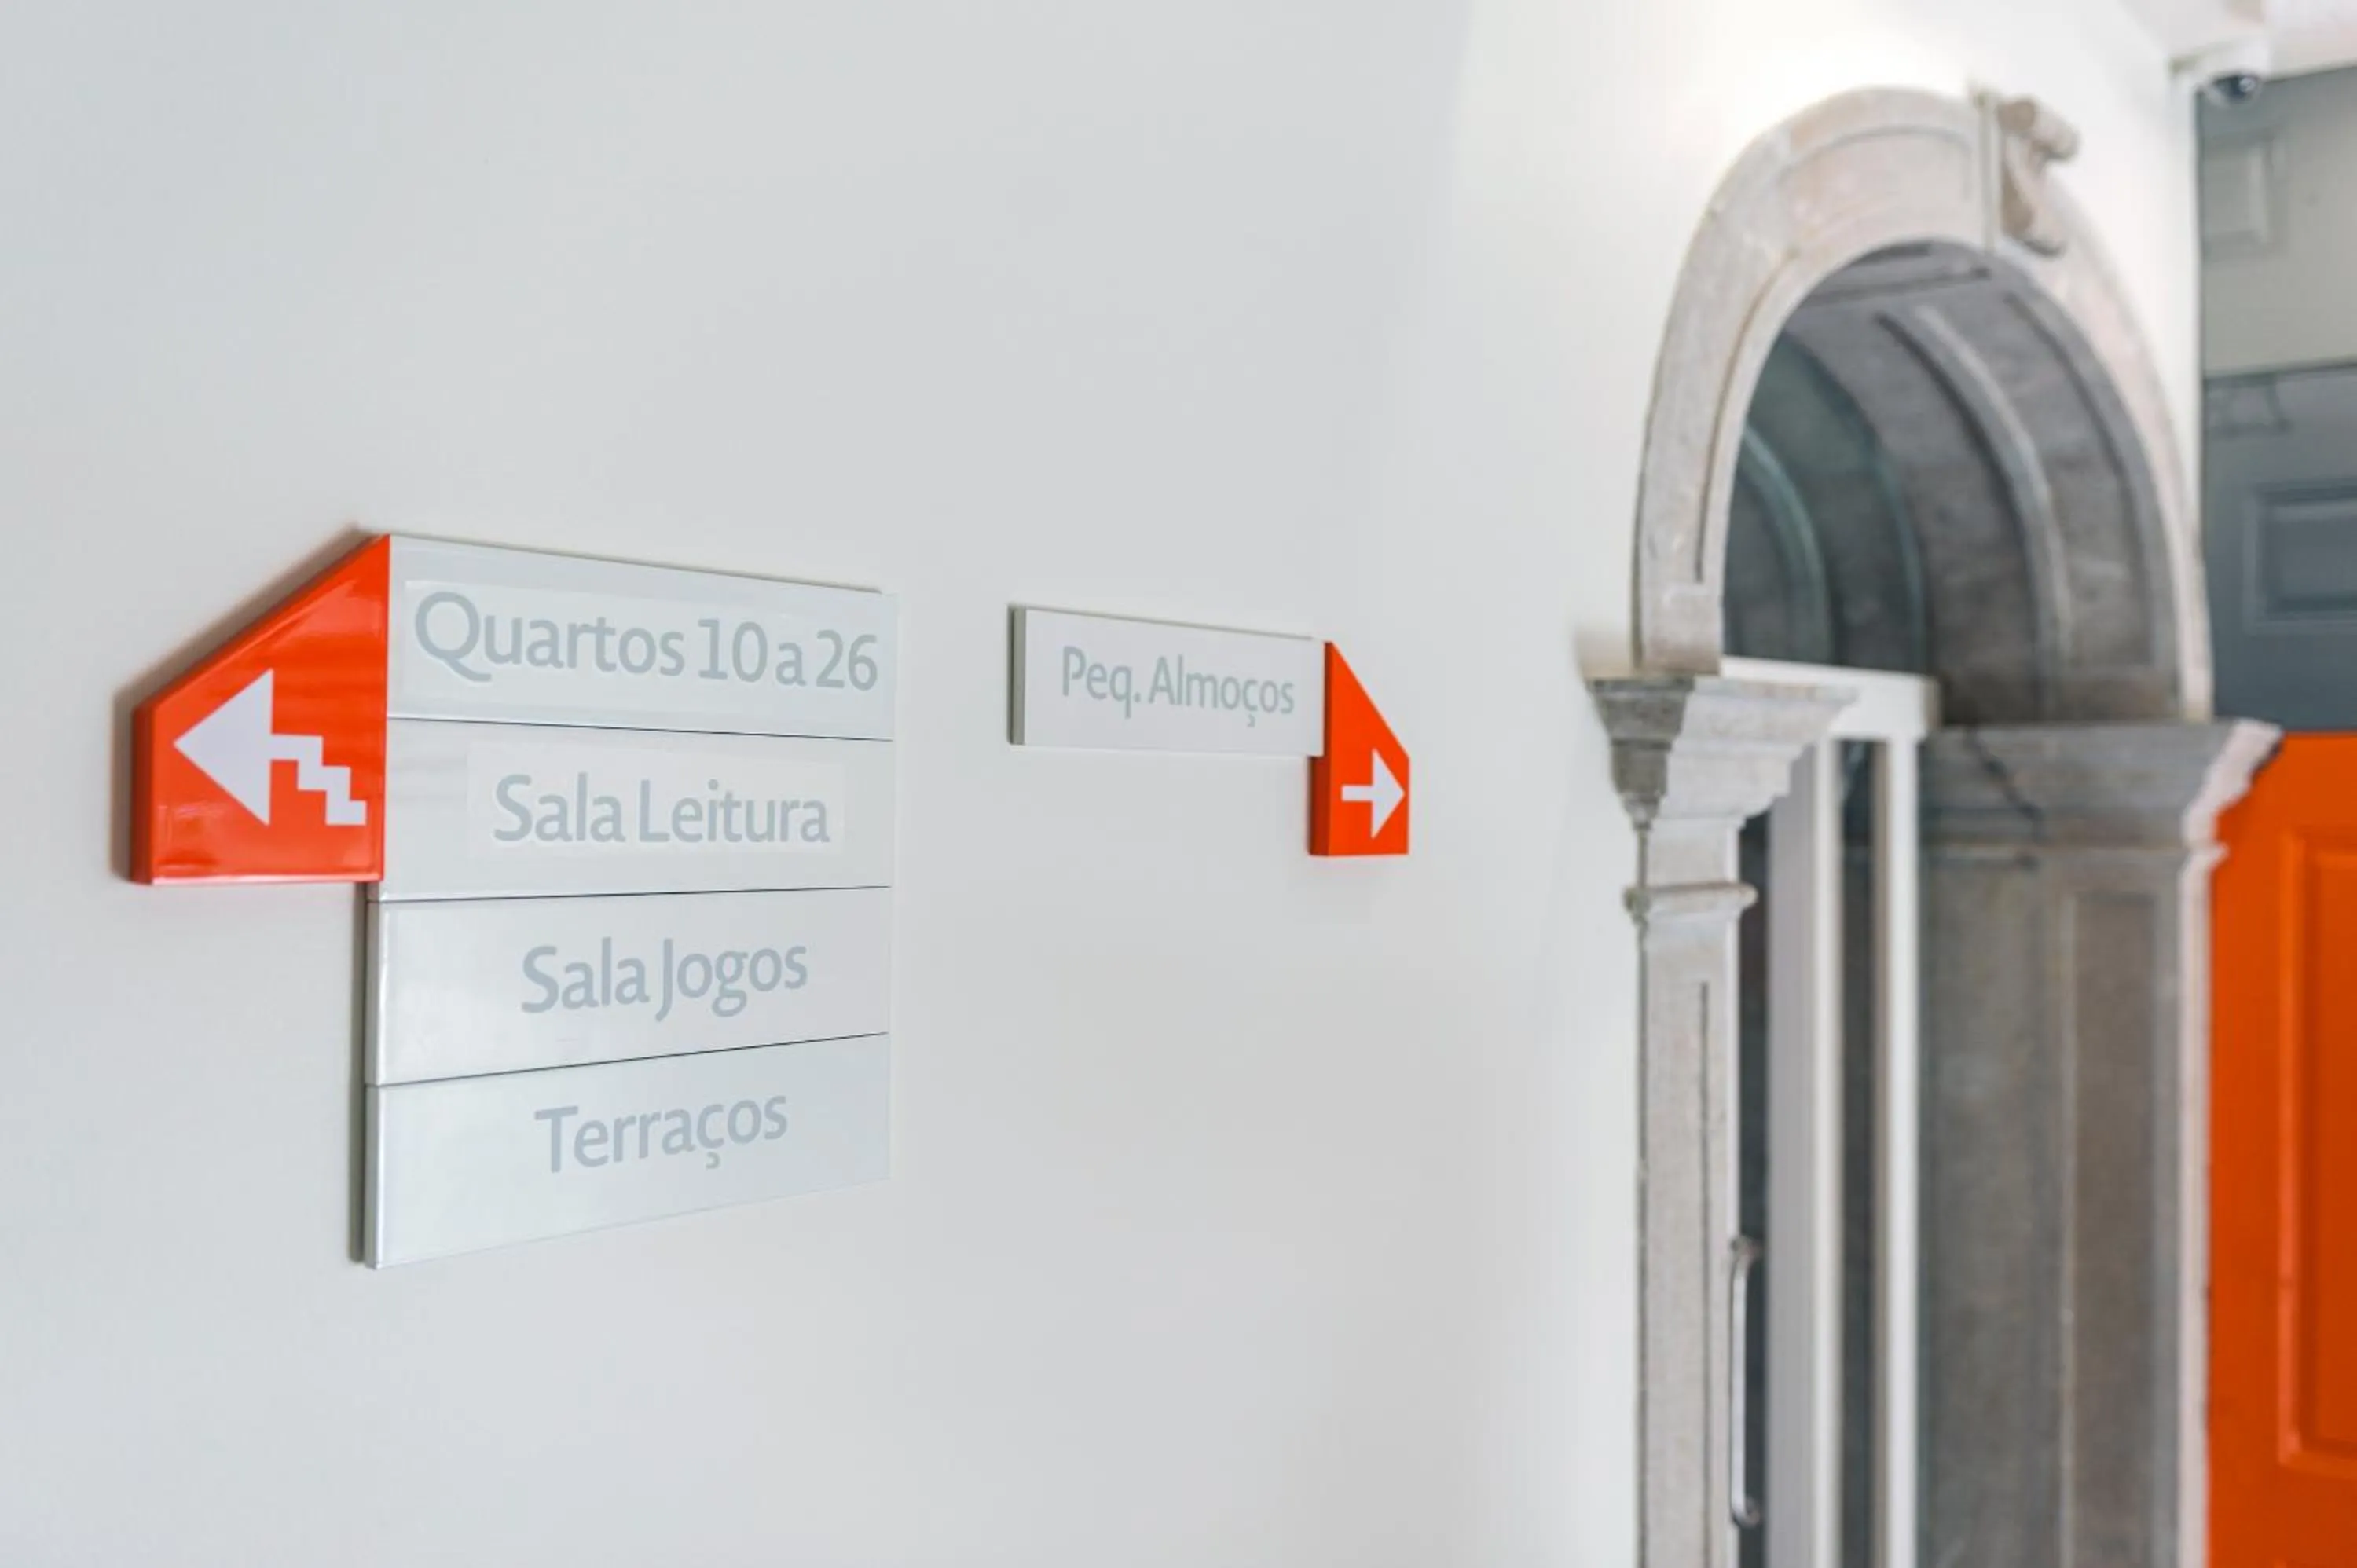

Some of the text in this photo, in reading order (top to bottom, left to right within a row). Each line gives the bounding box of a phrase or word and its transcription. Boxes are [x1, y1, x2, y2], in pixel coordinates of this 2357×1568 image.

[414, 591, 878, 691] Quartos 10 a 26
[1061, 645, 1296, 727] Peq. Almoços
[493, 771, 831, 844] Sala Leitura
[520, 936, 808, 1023] Sala Jogos
[533, 1095, 789, 1174] Terraços
